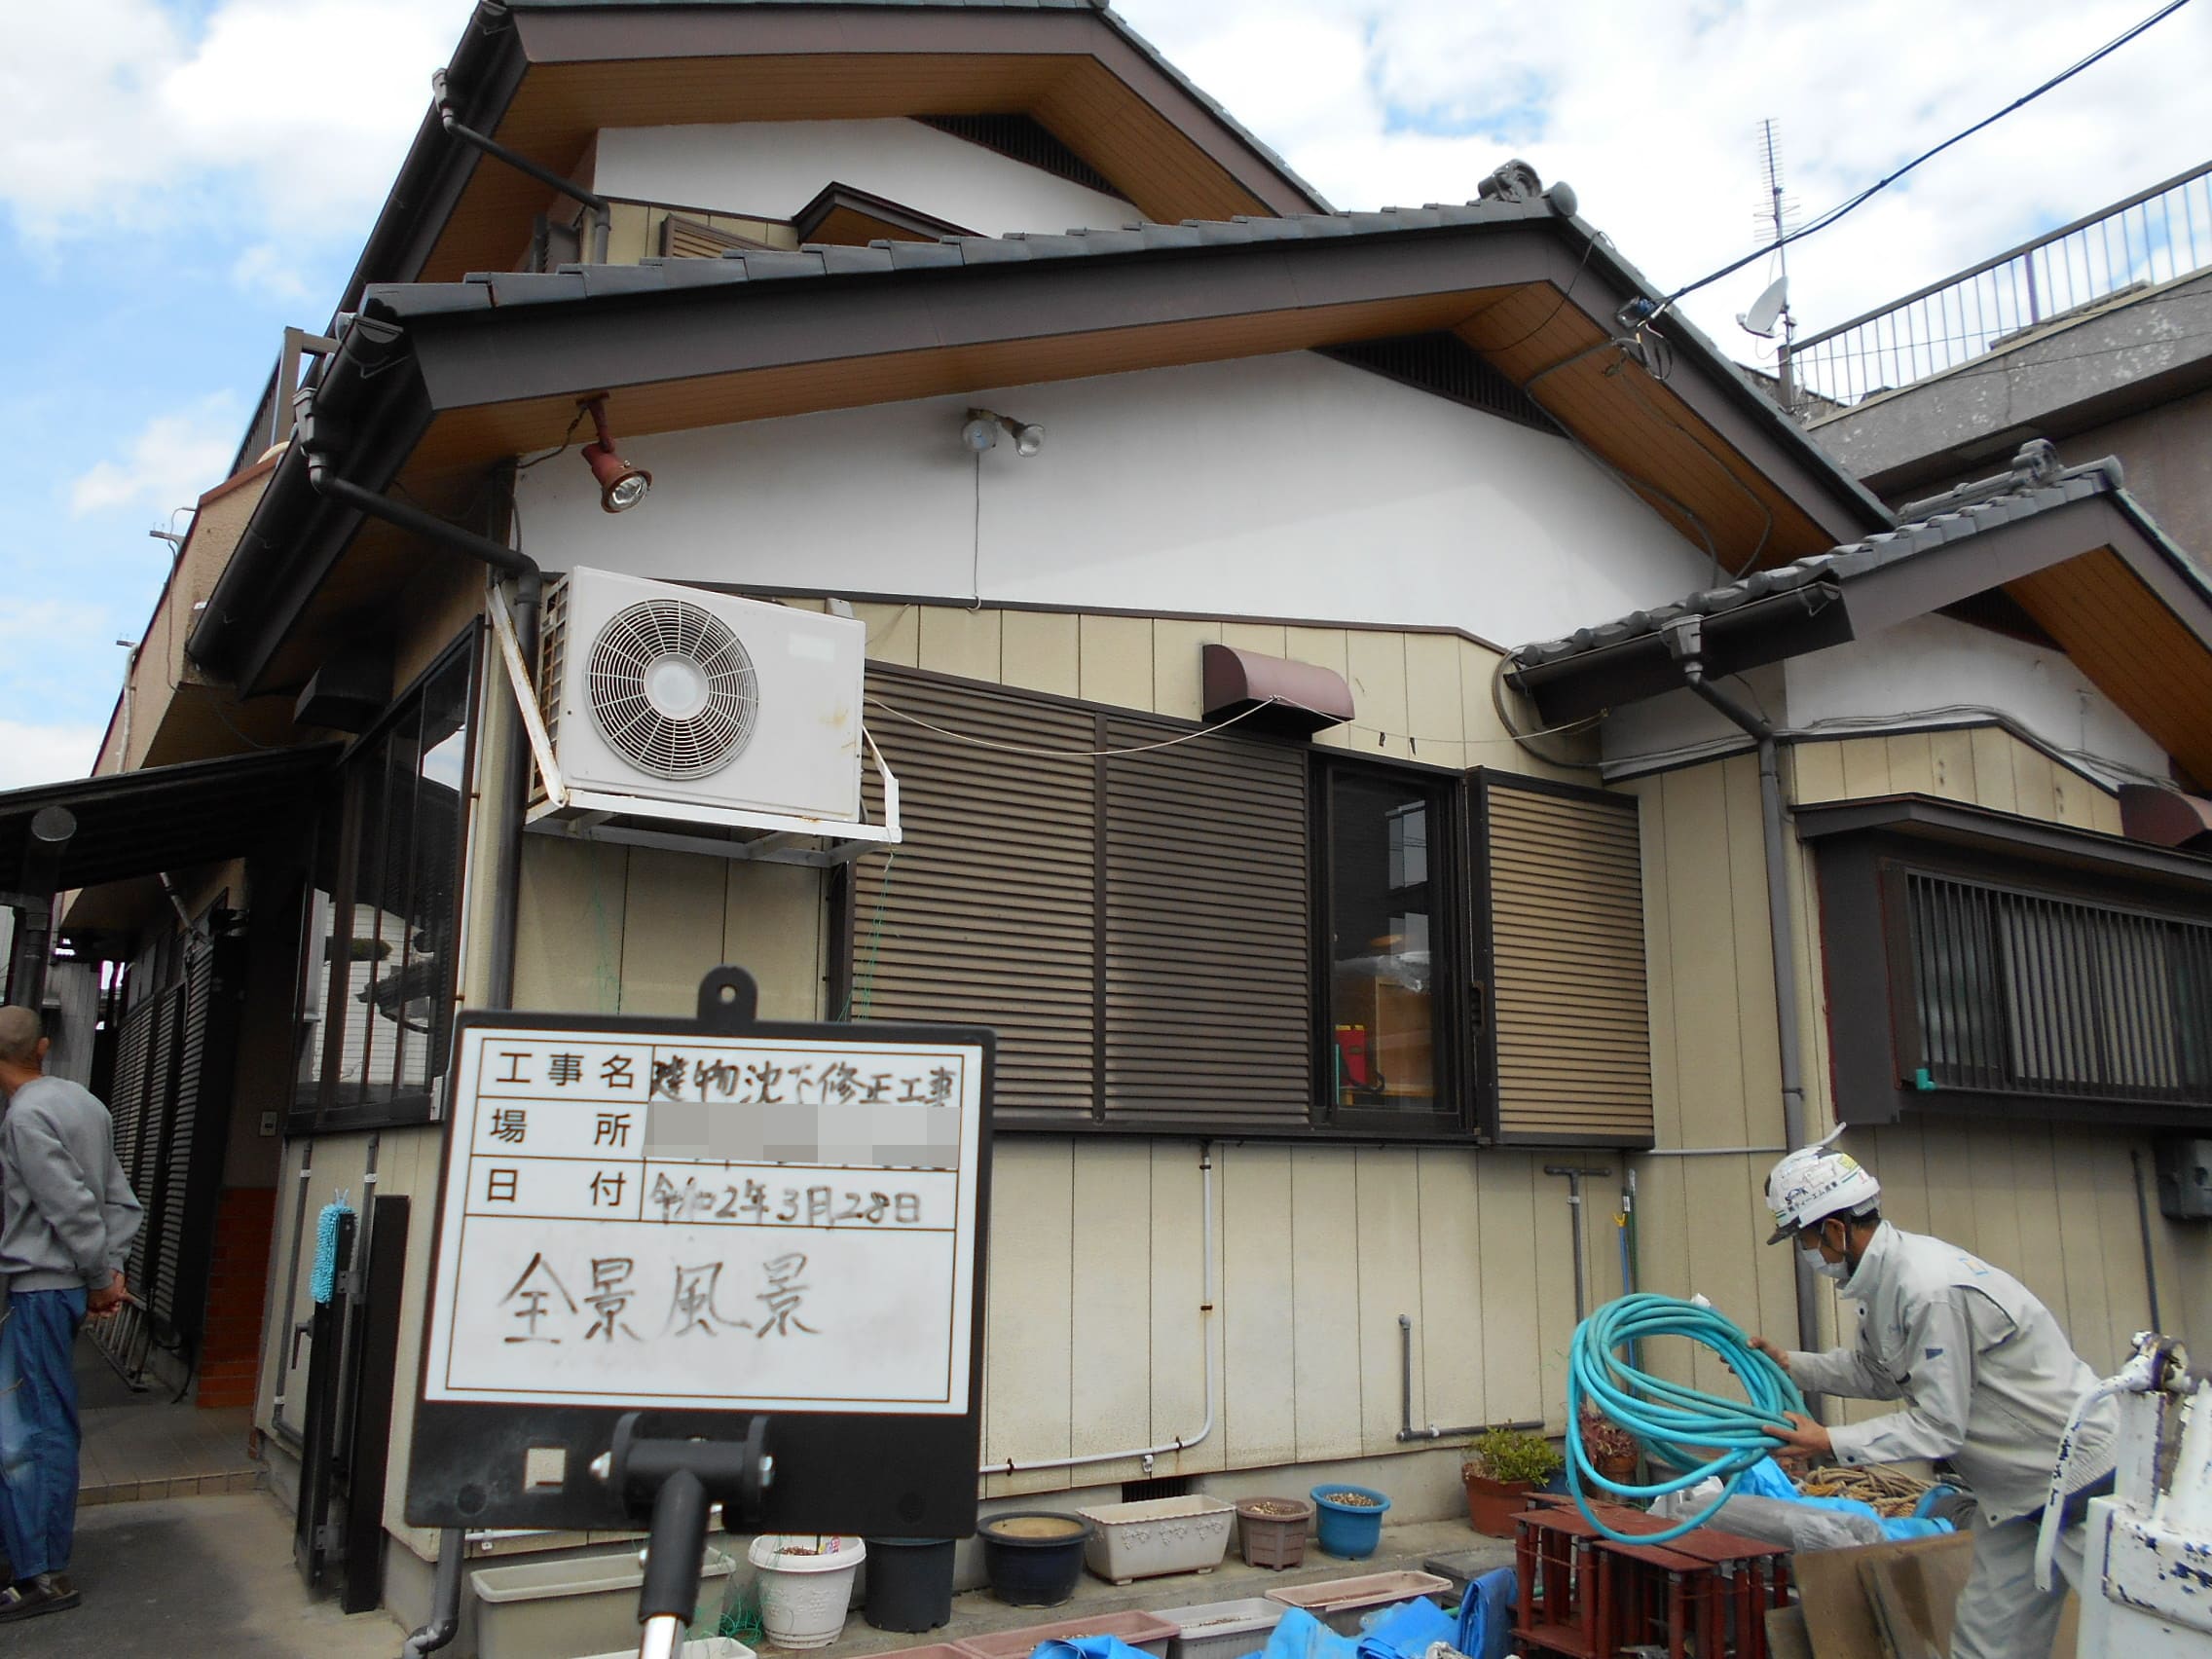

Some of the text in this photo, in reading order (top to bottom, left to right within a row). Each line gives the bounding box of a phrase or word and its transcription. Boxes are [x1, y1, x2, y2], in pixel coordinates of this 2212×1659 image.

[496, 1051, 635, 1089] 工事名
[489, 1108, 631, 1148] 場所
[487, 1168, 626, 1207] 日付
[498, 1251, 824, 1345] 全景風景
